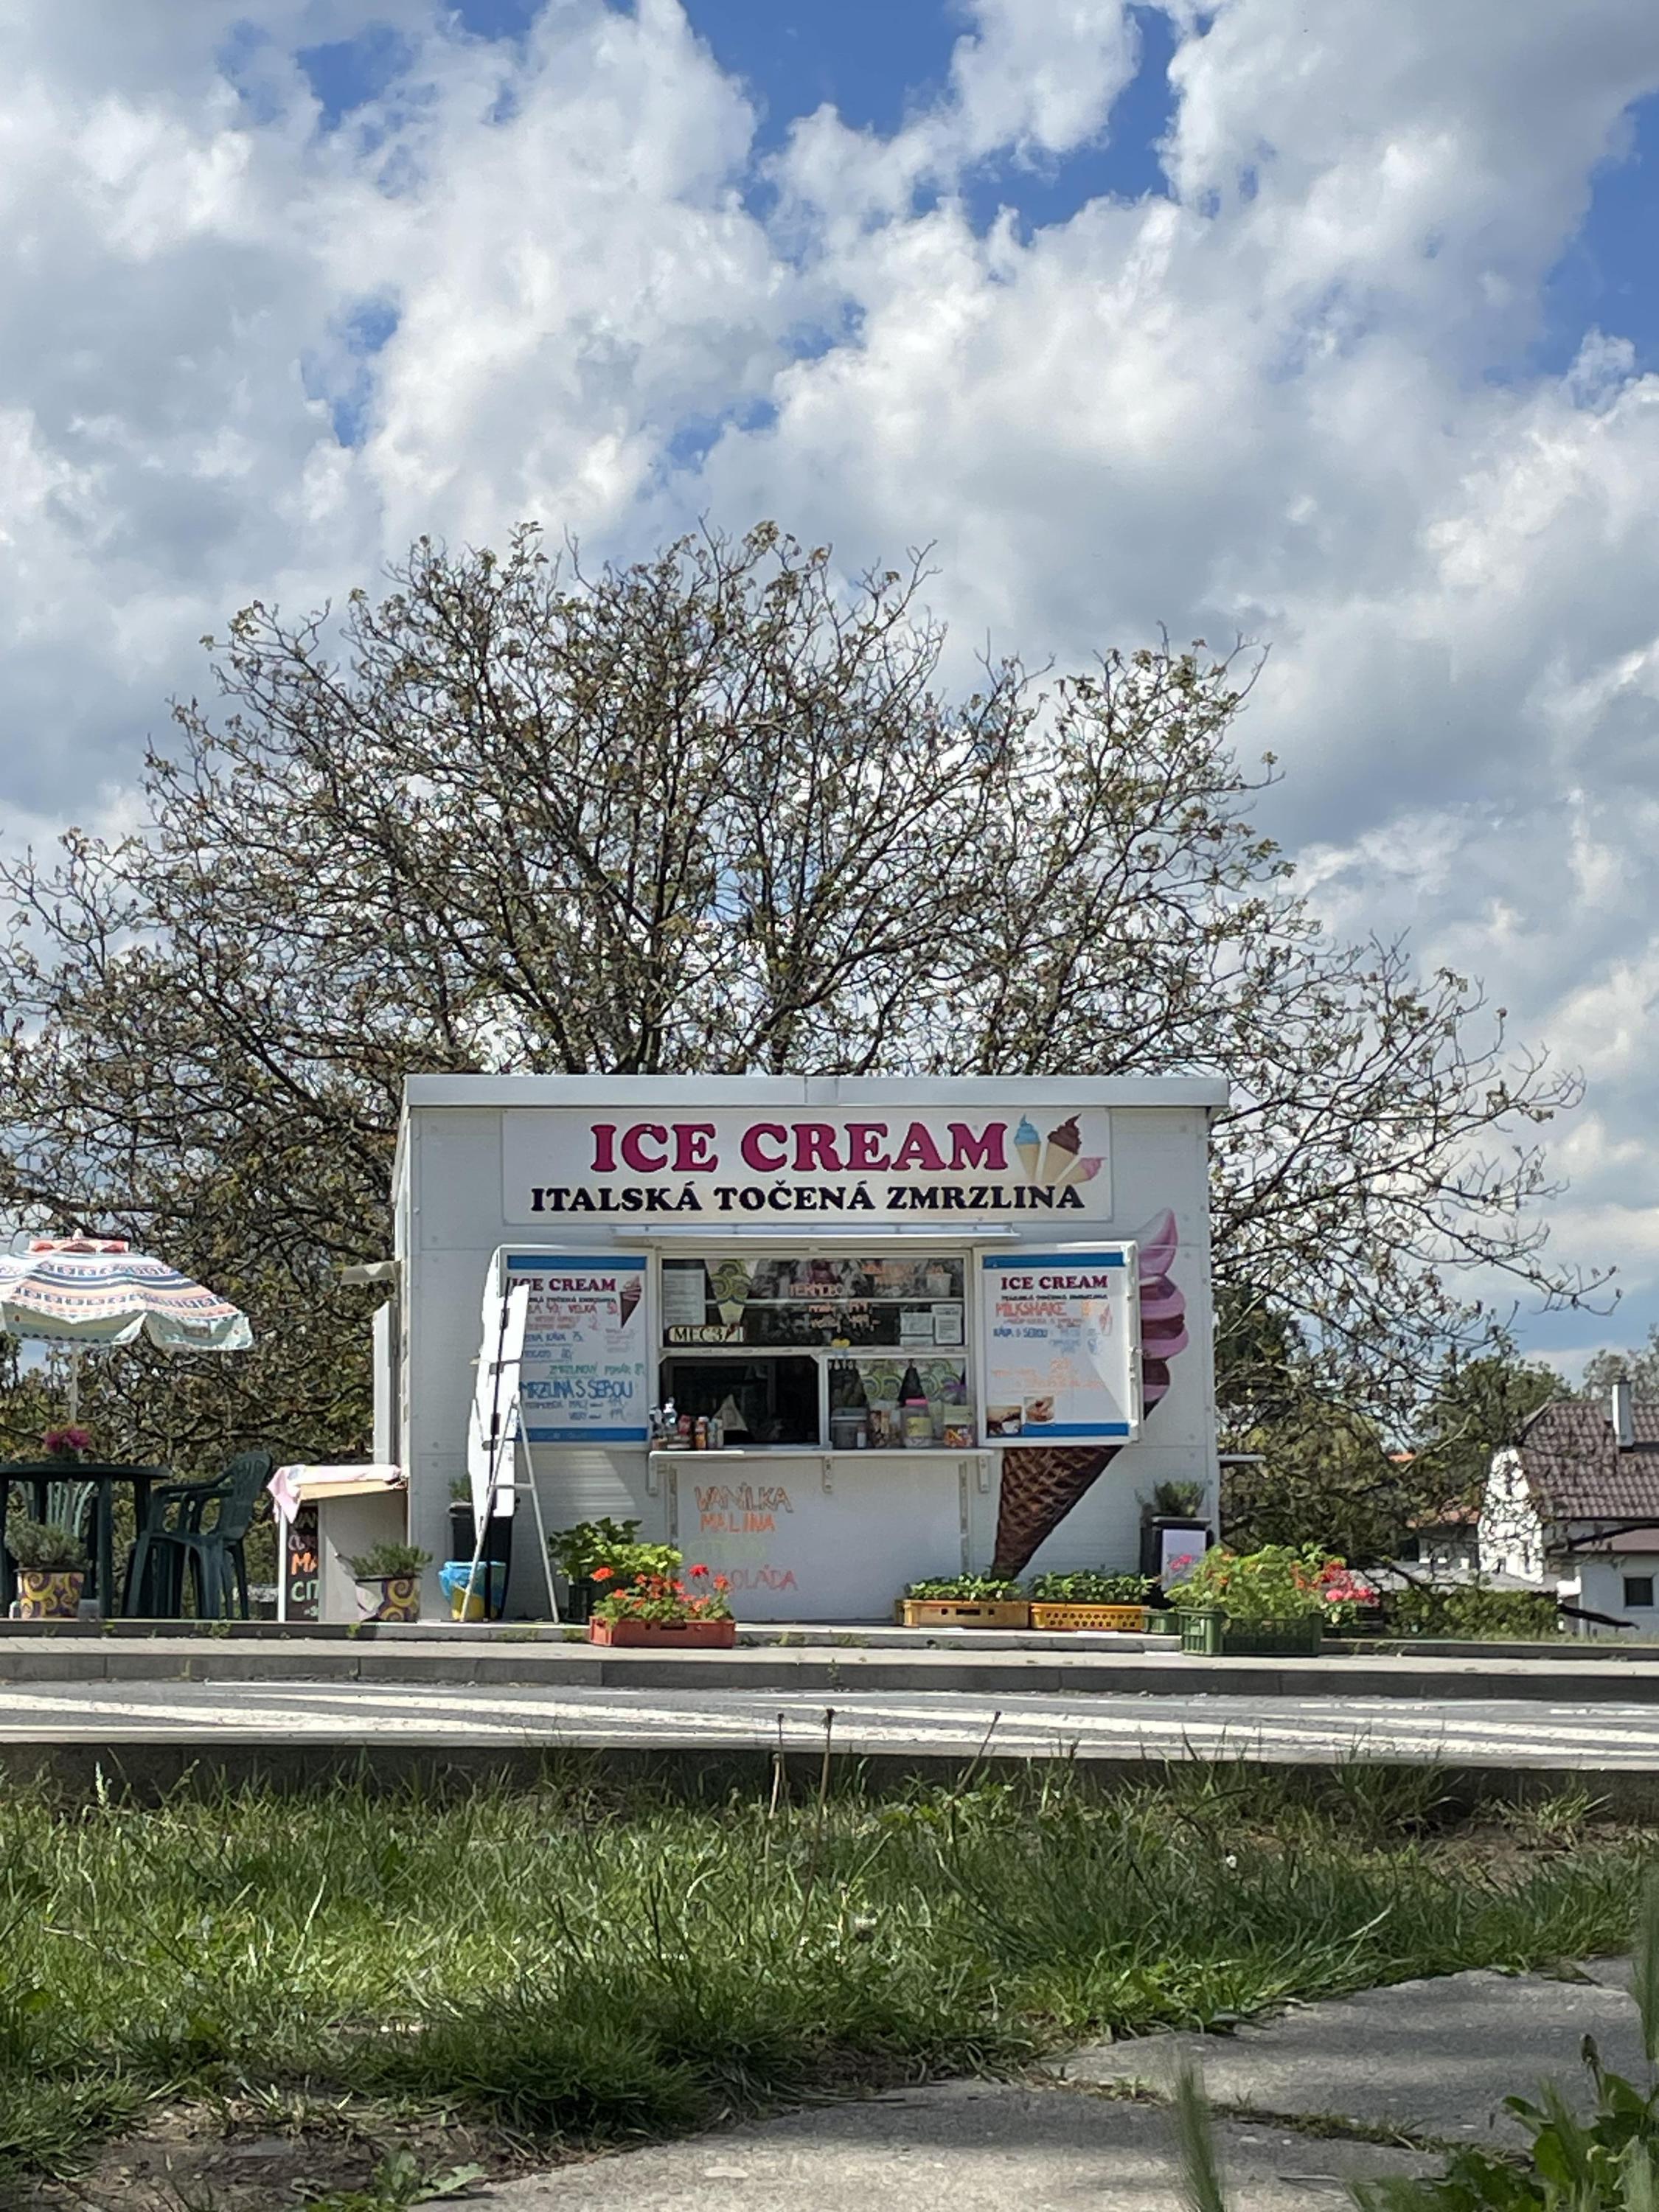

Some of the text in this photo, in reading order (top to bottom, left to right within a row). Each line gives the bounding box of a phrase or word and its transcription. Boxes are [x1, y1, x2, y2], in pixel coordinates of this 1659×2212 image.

[591, 1122, 1009, 1172] ICE CREAM
[531, 1180, 1085, 1211] ITALSKÁ TOČENÁ ZMRZLINA
[549, 1278, 616, 1292] CREAM
[1001, 1275, 1108, 1290] ICE CREAM
[674, 1327, 723, 1341] MEC3
[519, 1379, 633, 1399] MRZLINA S SEBOU
[700, 1512, 776, 1533] MALINA
